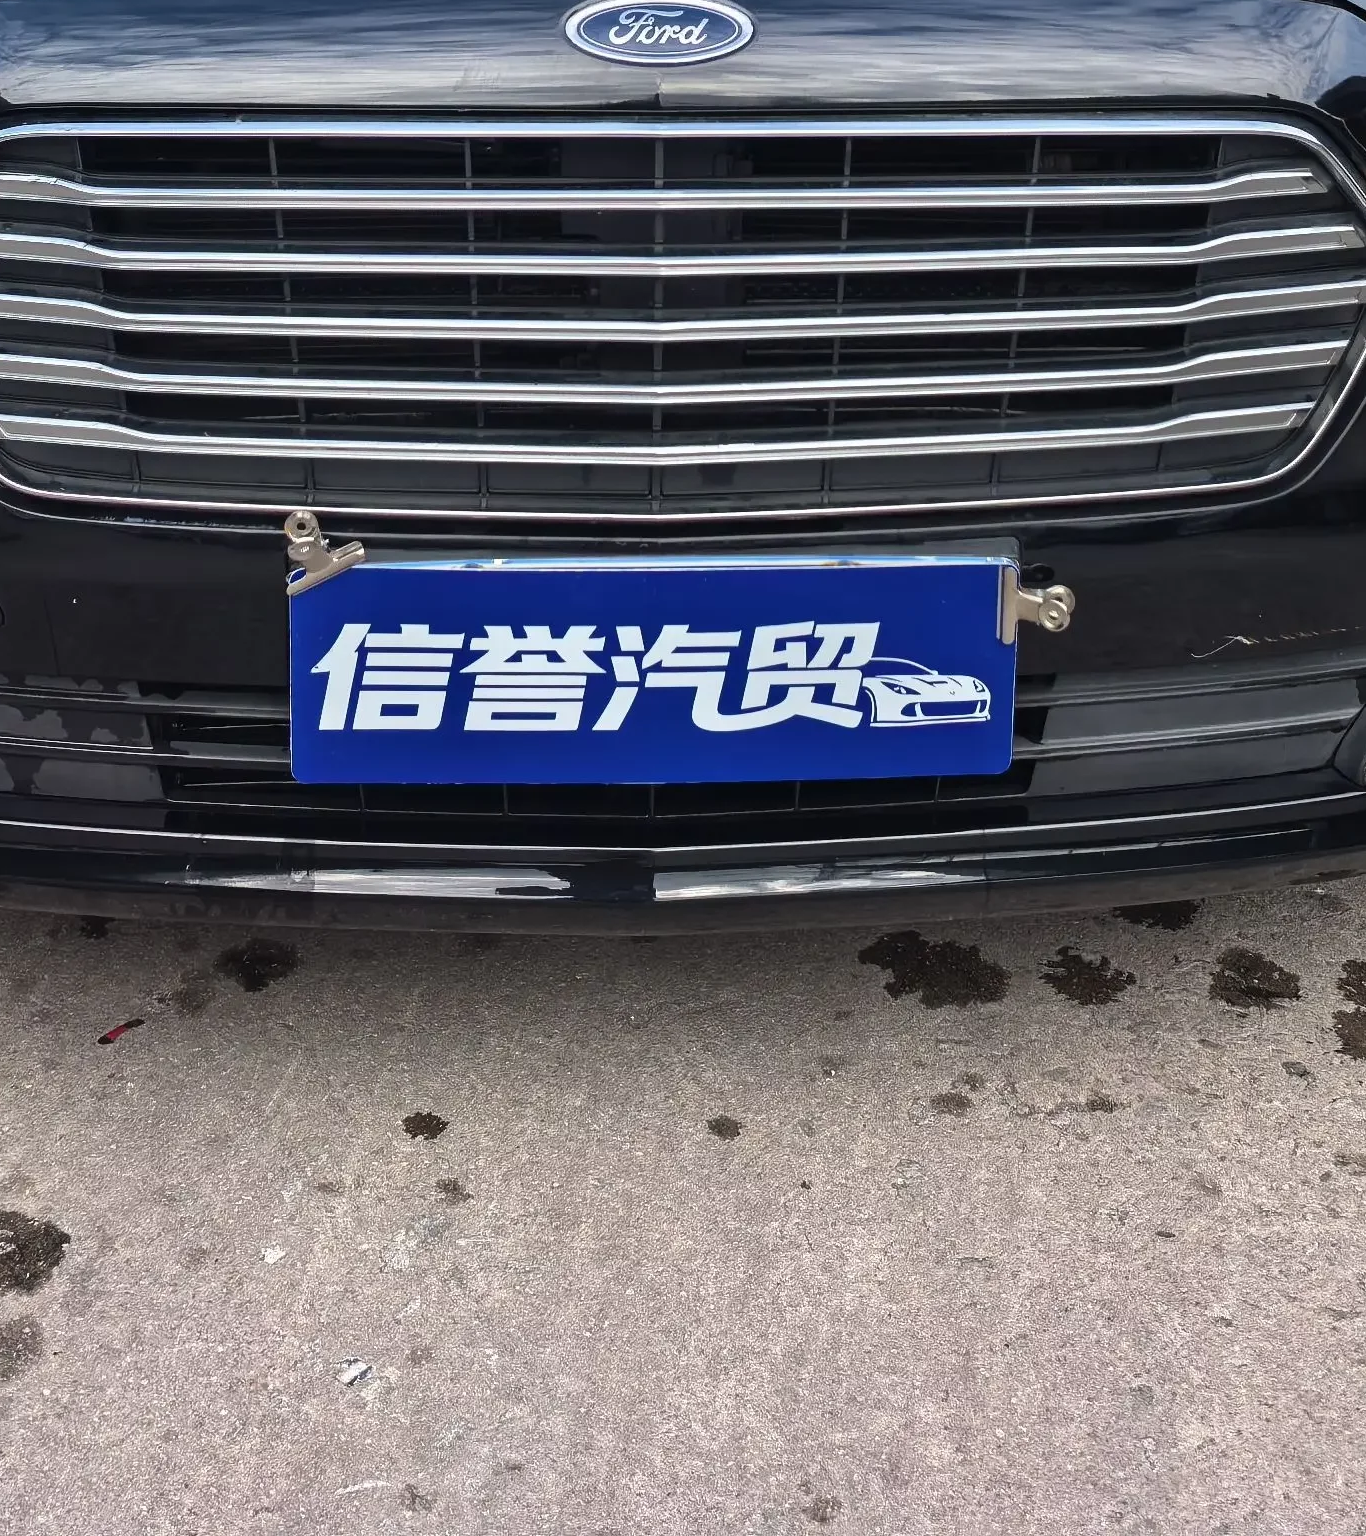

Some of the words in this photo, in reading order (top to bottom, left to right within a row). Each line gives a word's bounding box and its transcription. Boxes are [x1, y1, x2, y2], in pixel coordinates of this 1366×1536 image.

[608, 8, 709, 46] Ford
[310, 619, 881, 733] 信誉汽贸
